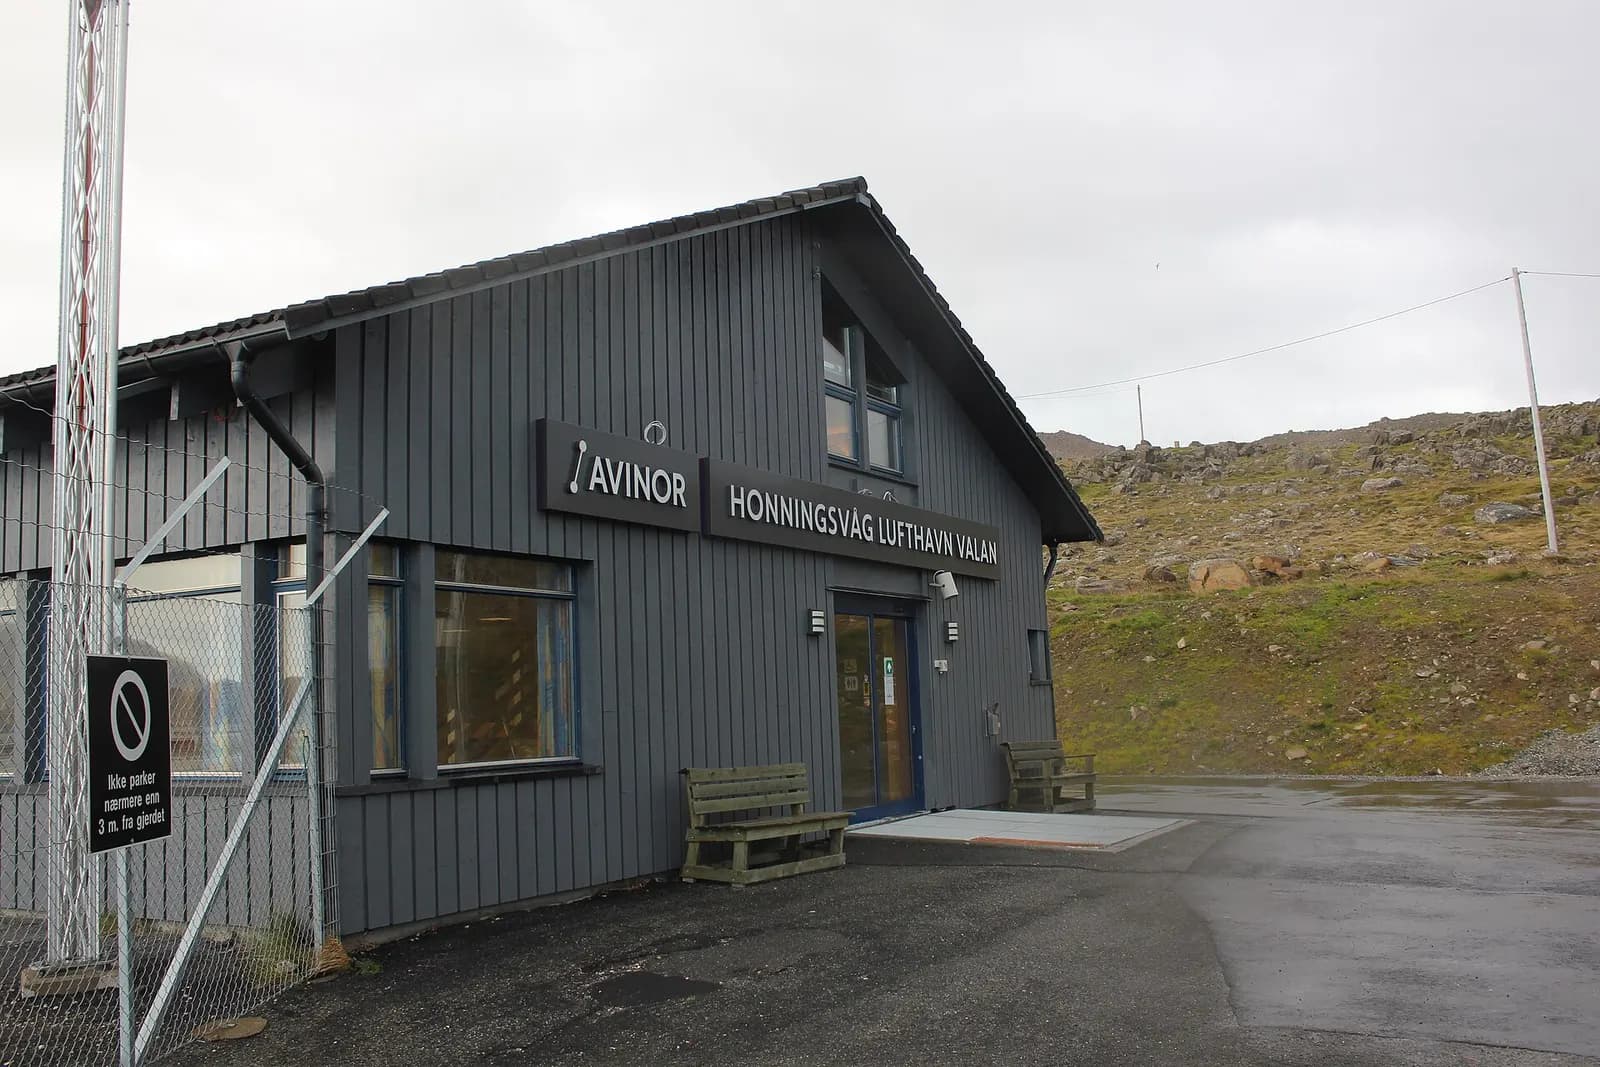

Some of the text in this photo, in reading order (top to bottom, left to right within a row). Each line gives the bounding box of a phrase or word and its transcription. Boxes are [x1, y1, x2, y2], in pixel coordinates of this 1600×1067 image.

[589, 456, 687, 508] AVINOR
[730, 484, 997, 565] HONNINGSVÅG LUFTHAVN VALAN
[108, 771, 156, 790] Ikke parker
[104, 791, 160, 813] nærmere enn
[98, 809, 165, 835] 3 m. fra gjerdet
